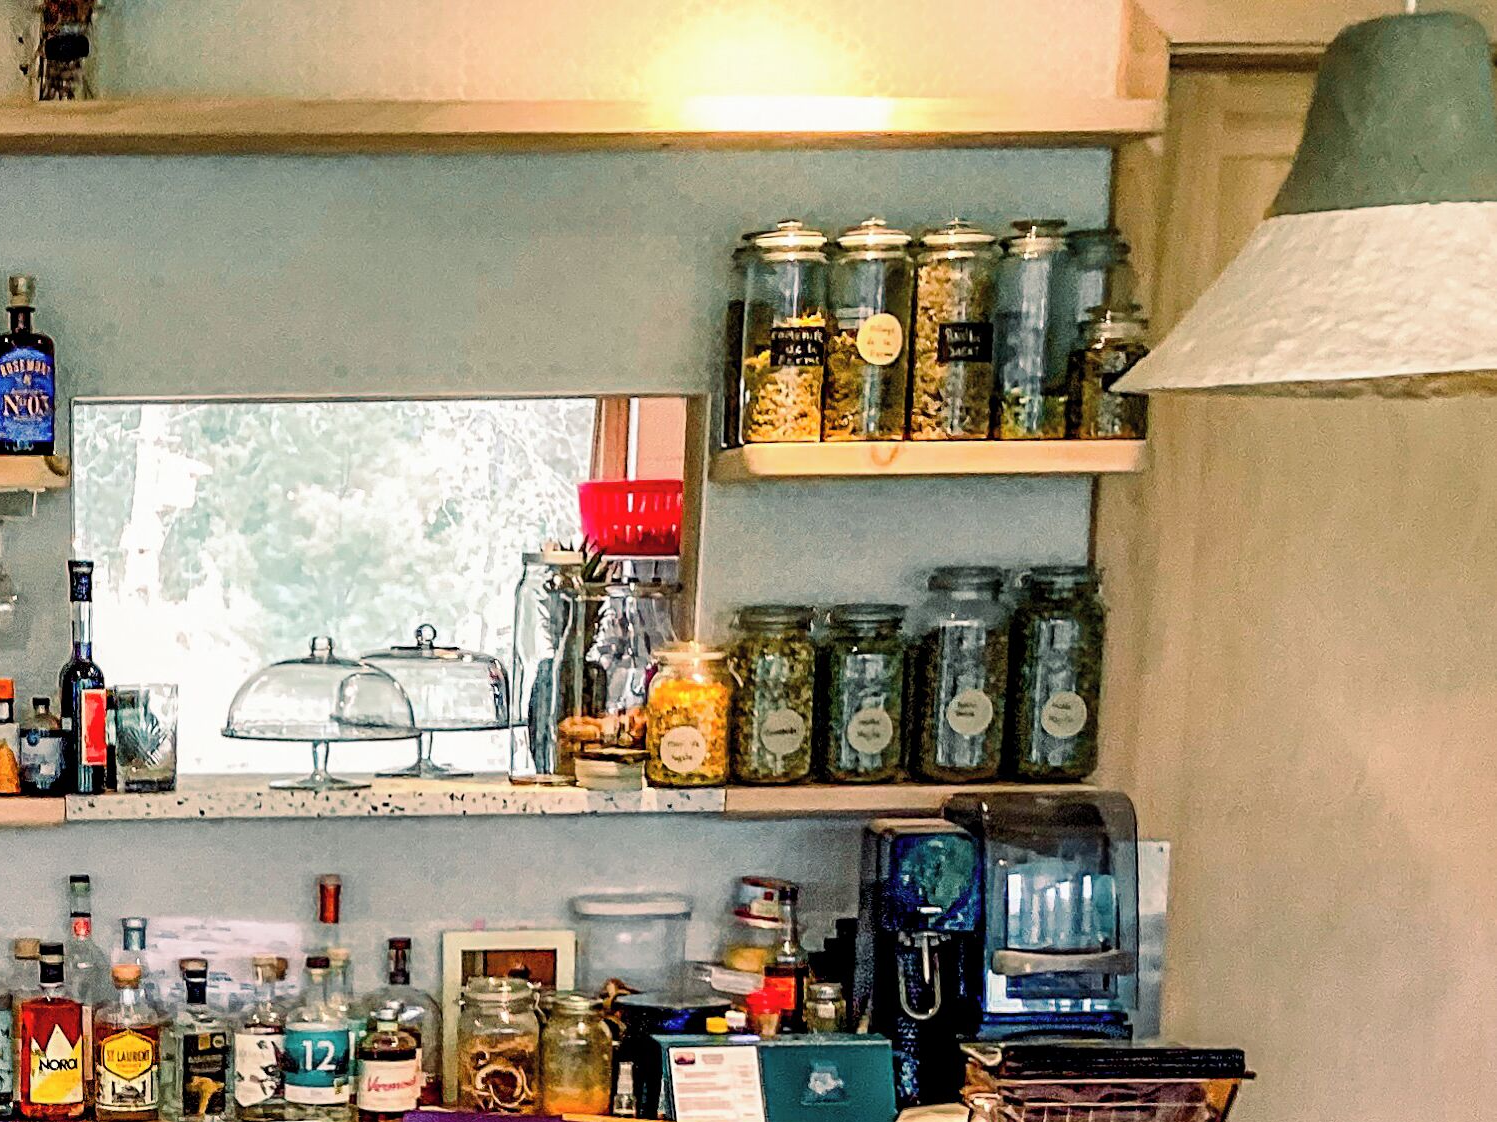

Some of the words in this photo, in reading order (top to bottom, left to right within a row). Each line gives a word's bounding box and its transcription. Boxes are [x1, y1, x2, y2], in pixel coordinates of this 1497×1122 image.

[0, 358, 51, 377] ROSEMONT
[117, 1049, 150, 1063] LAURENT
[303, 1039, 336, 1071] 12
[39, 1059, 78, 1071] NOROI
